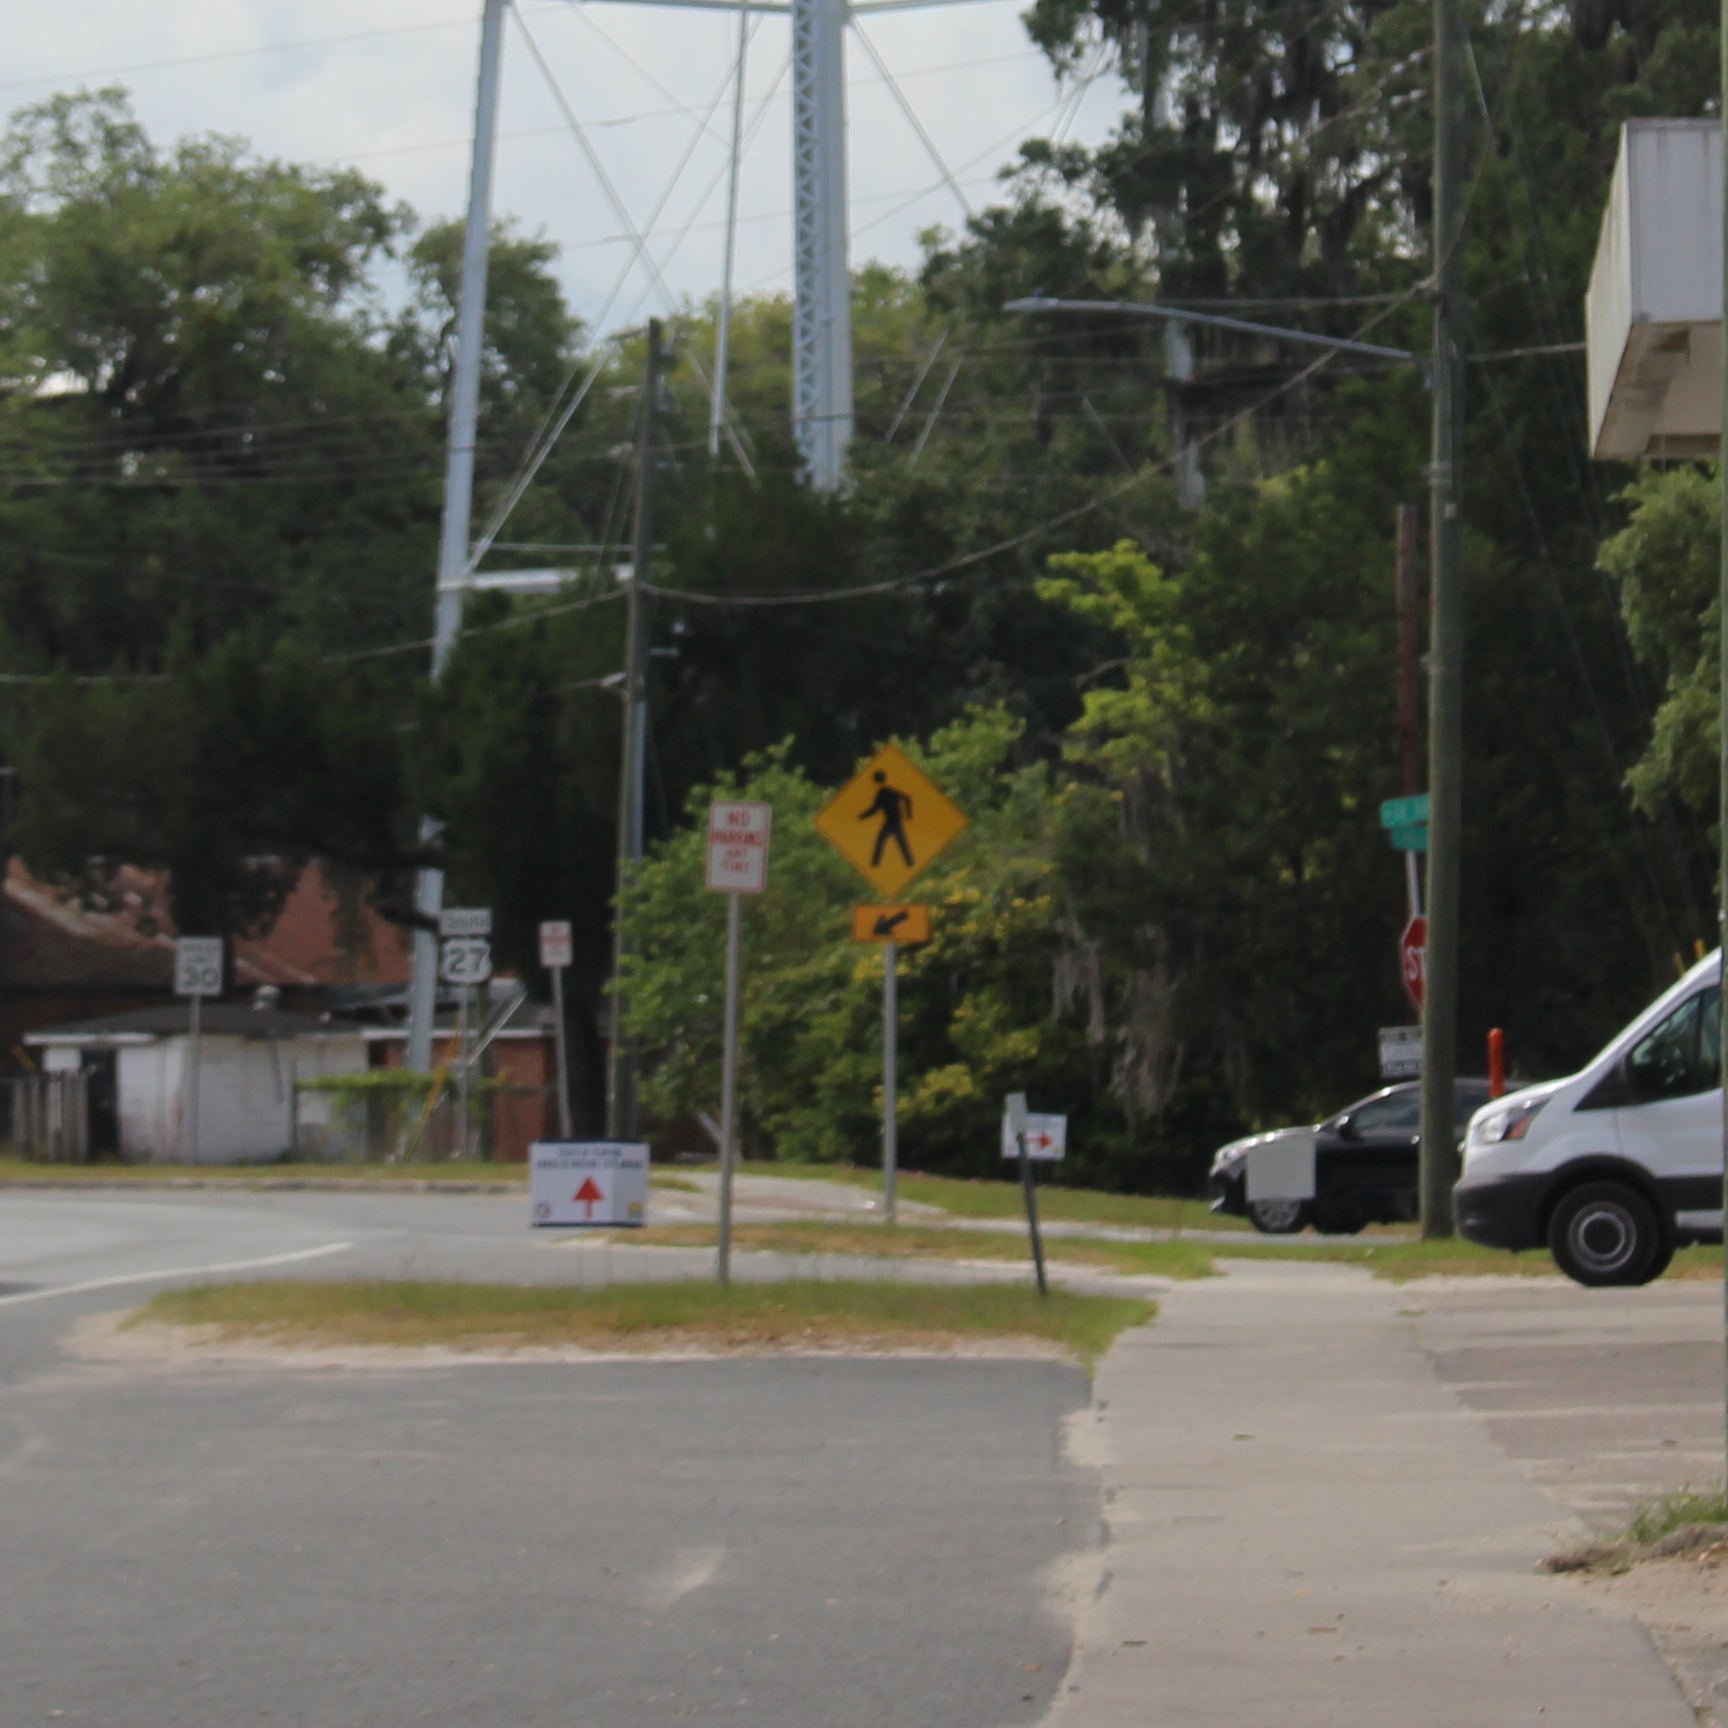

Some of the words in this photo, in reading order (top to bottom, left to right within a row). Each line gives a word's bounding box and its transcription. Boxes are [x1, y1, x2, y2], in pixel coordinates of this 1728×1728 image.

[728, 812, 750, 826] NO
[449, 948, 487, 973] 27
[1407, 945, 1428, 981] ST
[183, 966, 221, 988] 30
